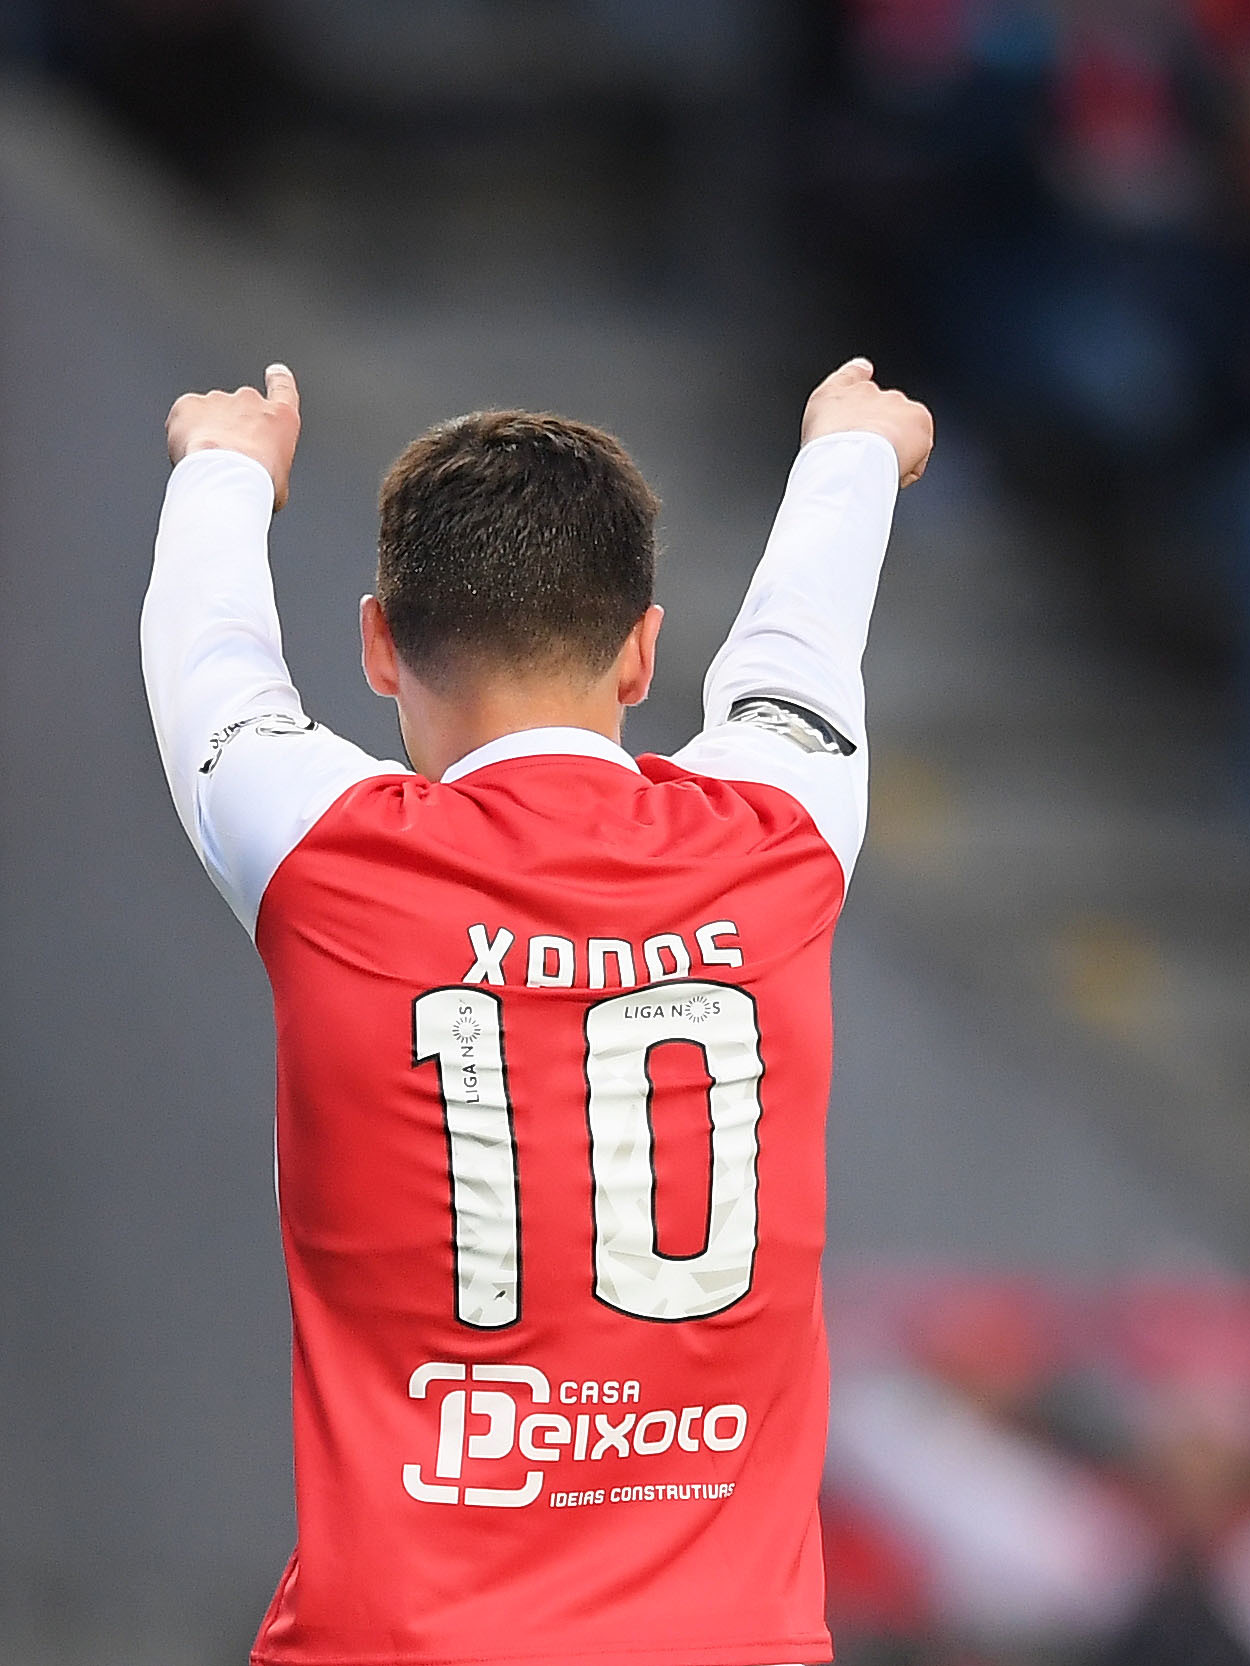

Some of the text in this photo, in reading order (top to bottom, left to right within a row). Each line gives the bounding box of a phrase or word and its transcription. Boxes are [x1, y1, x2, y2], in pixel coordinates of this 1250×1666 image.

[624, 1005, 665, 1019] LIGA
[462, 1063, 480, 1104] LIGA
[411, 978, 766, 1331] 10
[559, 1380, 640, 1404] CASA
[549, 1489, 606, 1509] IDEIAS
